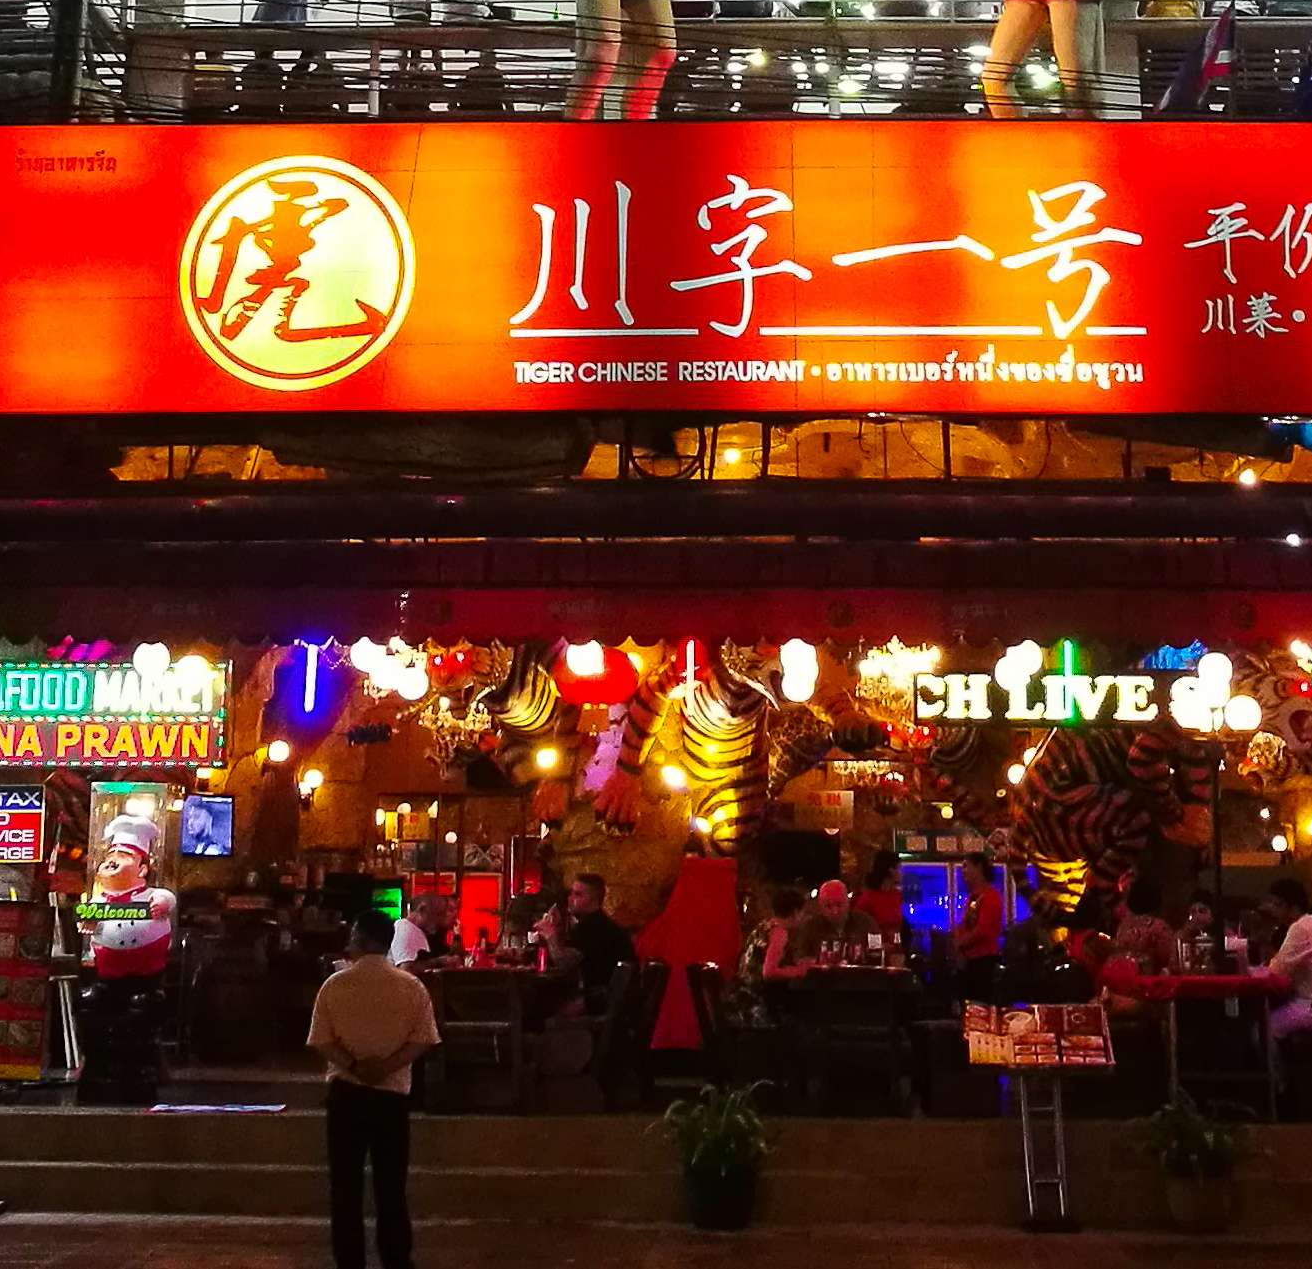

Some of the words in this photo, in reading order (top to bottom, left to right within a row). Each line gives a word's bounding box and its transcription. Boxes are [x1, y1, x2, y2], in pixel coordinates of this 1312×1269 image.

[510, 174, 1143, 340] 川字一号
[514, 361, 575, 383] TIGER
[577, 361, 668, 383] CHINESE
[678, 360, 806, 382] RESTAURANT
[56, 723, 209, 758] PRAWN
[76, 903, 147, 919] Welcome
